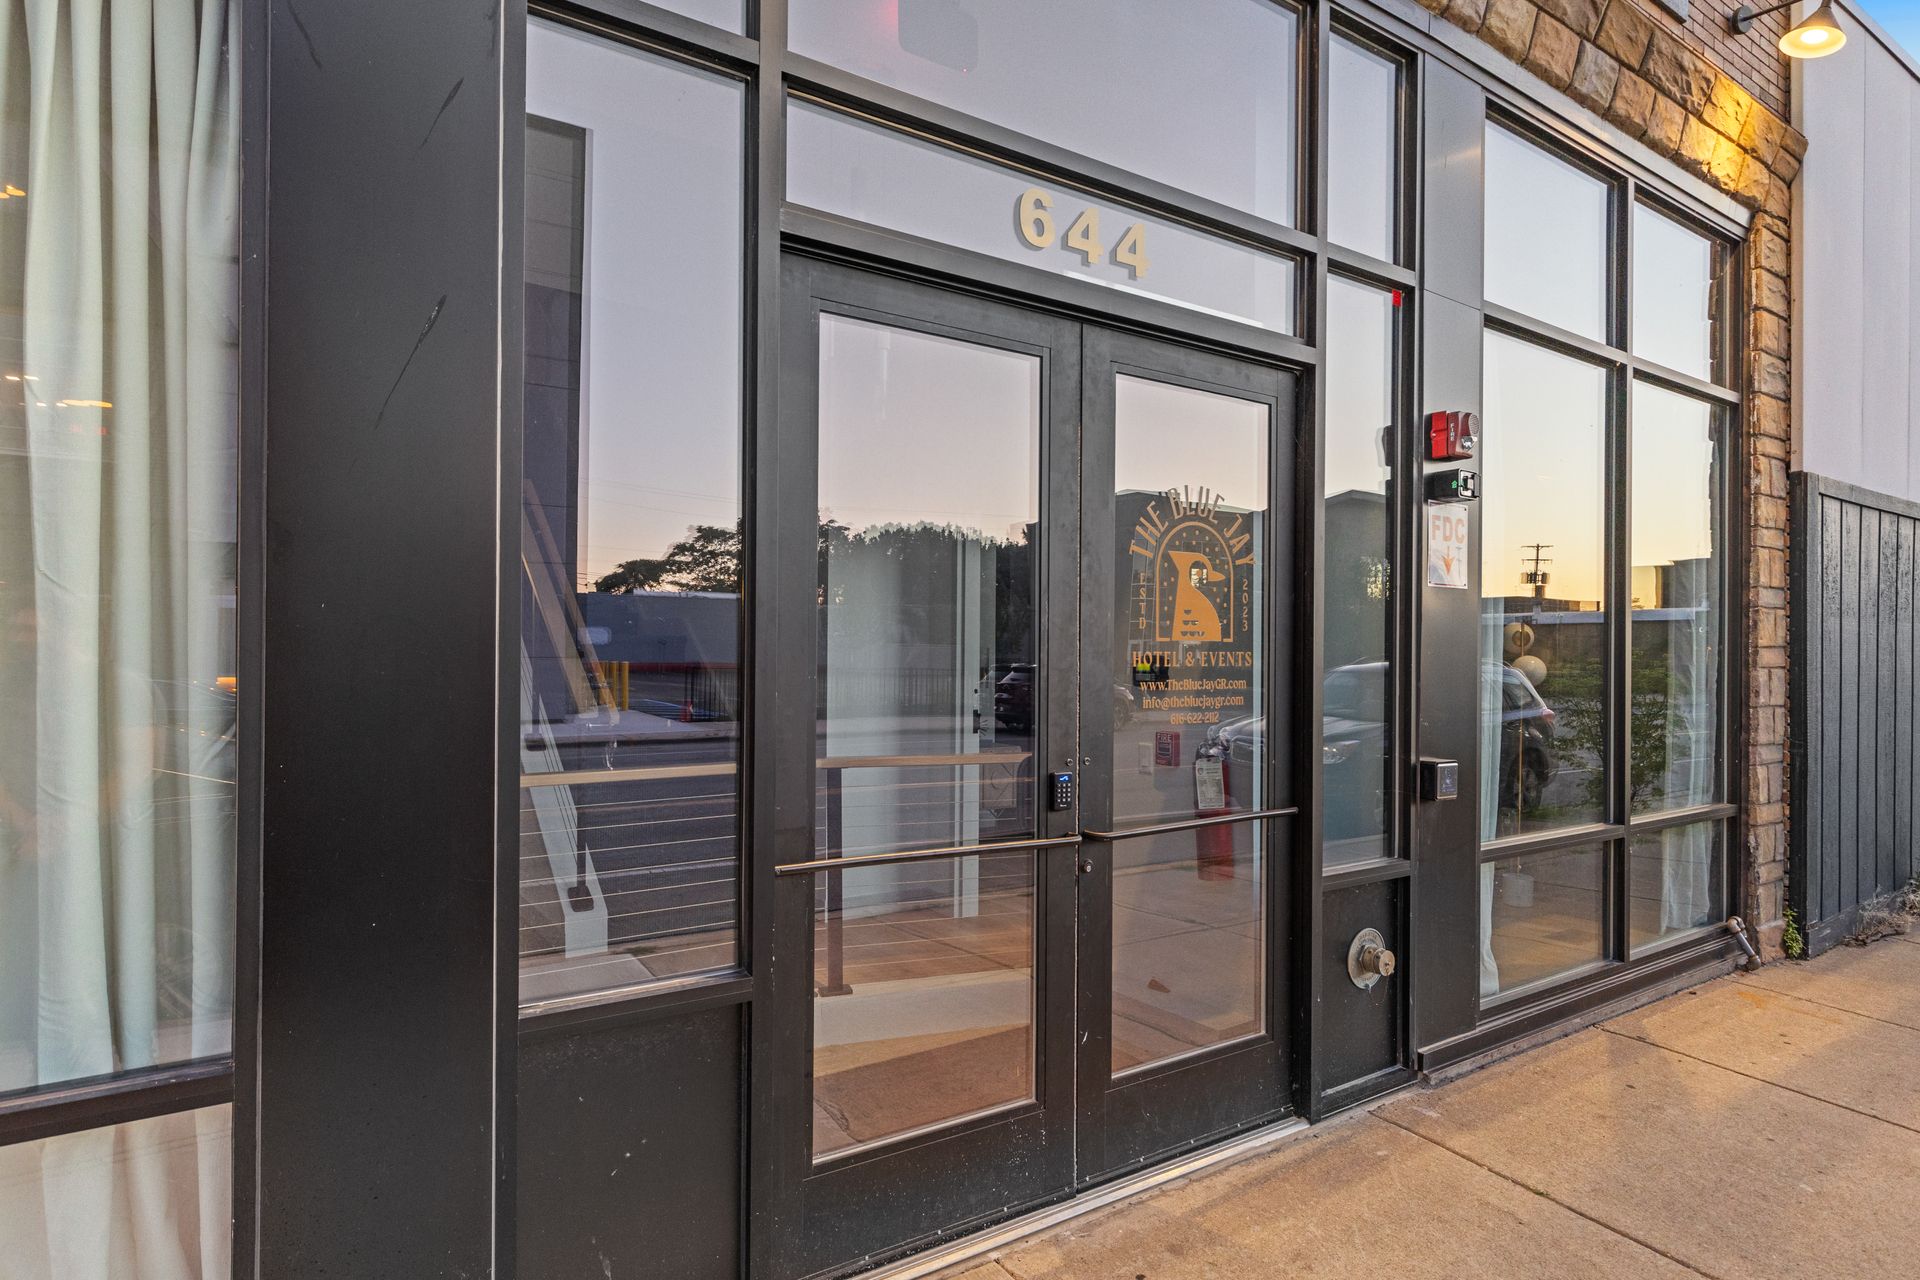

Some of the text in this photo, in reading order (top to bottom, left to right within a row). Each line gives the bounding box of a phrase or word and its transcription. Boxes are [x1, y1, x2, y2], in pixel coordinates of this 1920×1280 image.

[1018, 187, 1152, 279] 644
[1128, 484, 1257, 566] THE BLUE JAY
[1431, 514, 1467, 544] FDC
[1139, 572, 1147, 630] ESTD
[1132, 650, 1252, 668] HOTEL & EVENTS
[1140, 678, 1247, 692] www.TheBlueJayGR.com
[1142, 695, 1244, 710] info@thebluejaygr.com
[1170, 711, 1219, 725] 616-622-2112
